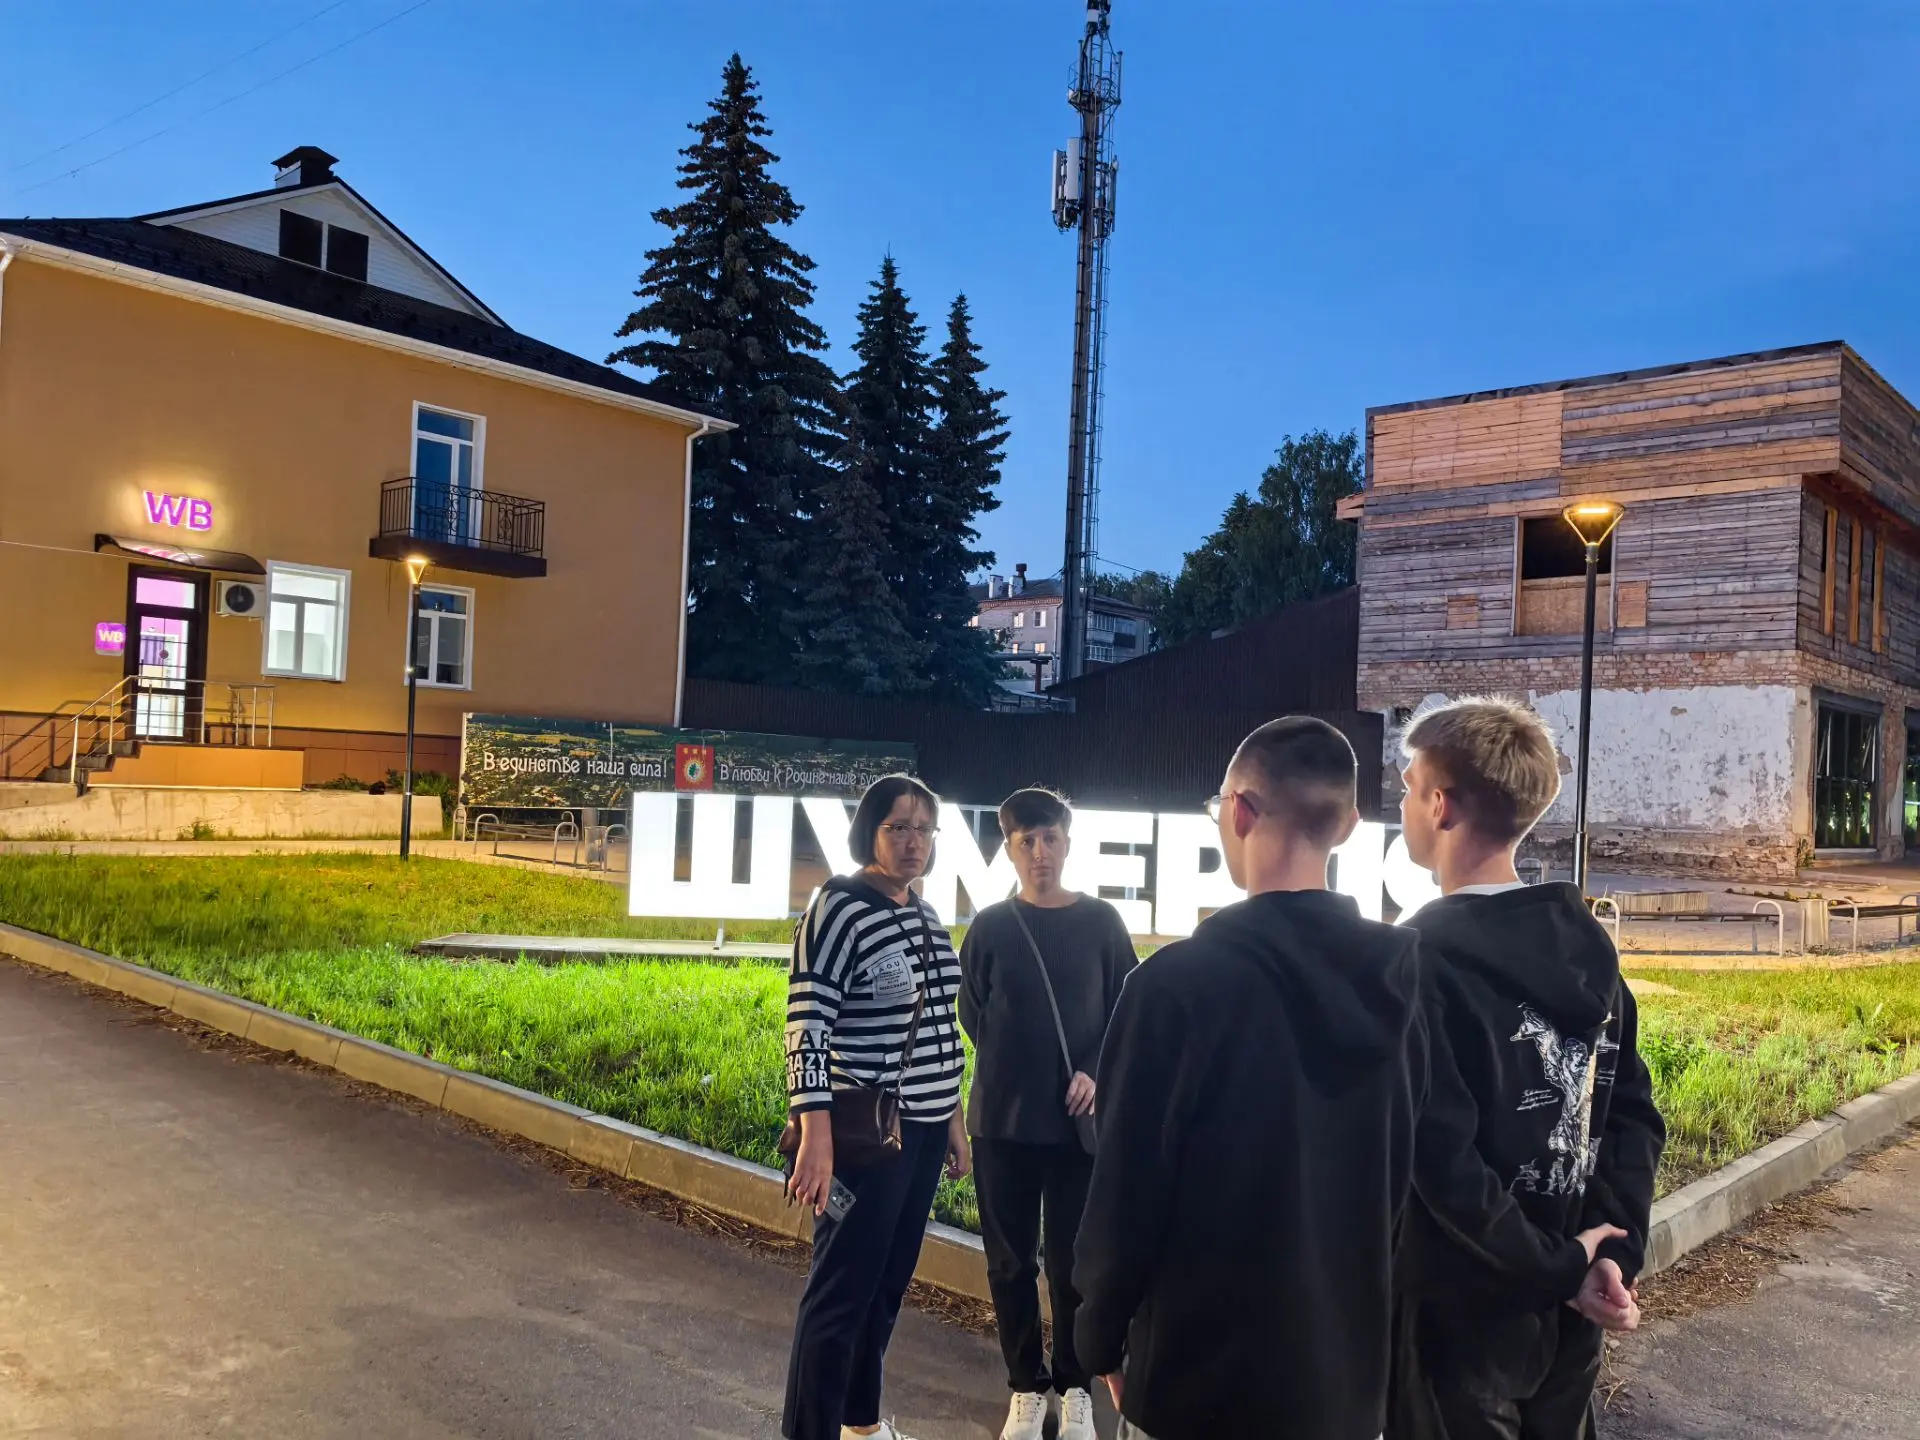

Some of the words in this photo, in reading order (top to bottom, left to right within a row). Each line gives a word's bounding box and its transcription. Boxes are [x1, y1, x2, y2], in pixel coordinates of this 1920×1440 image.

[143, 490, 213, 532] WB
[98, 630, 124, 643] WB
[483, 750, 496, 771] В
[500, 757, 580, 779] единстве
[587, 762, 624, 776] наша
[630, 759, 667, 778] сила!
[720, 764, 729, 780] В
[732, 768, 770, 782] любви
[787, 1052, 827, 1072] RAZY
[788, 1070, 829, 1090] OTOR
